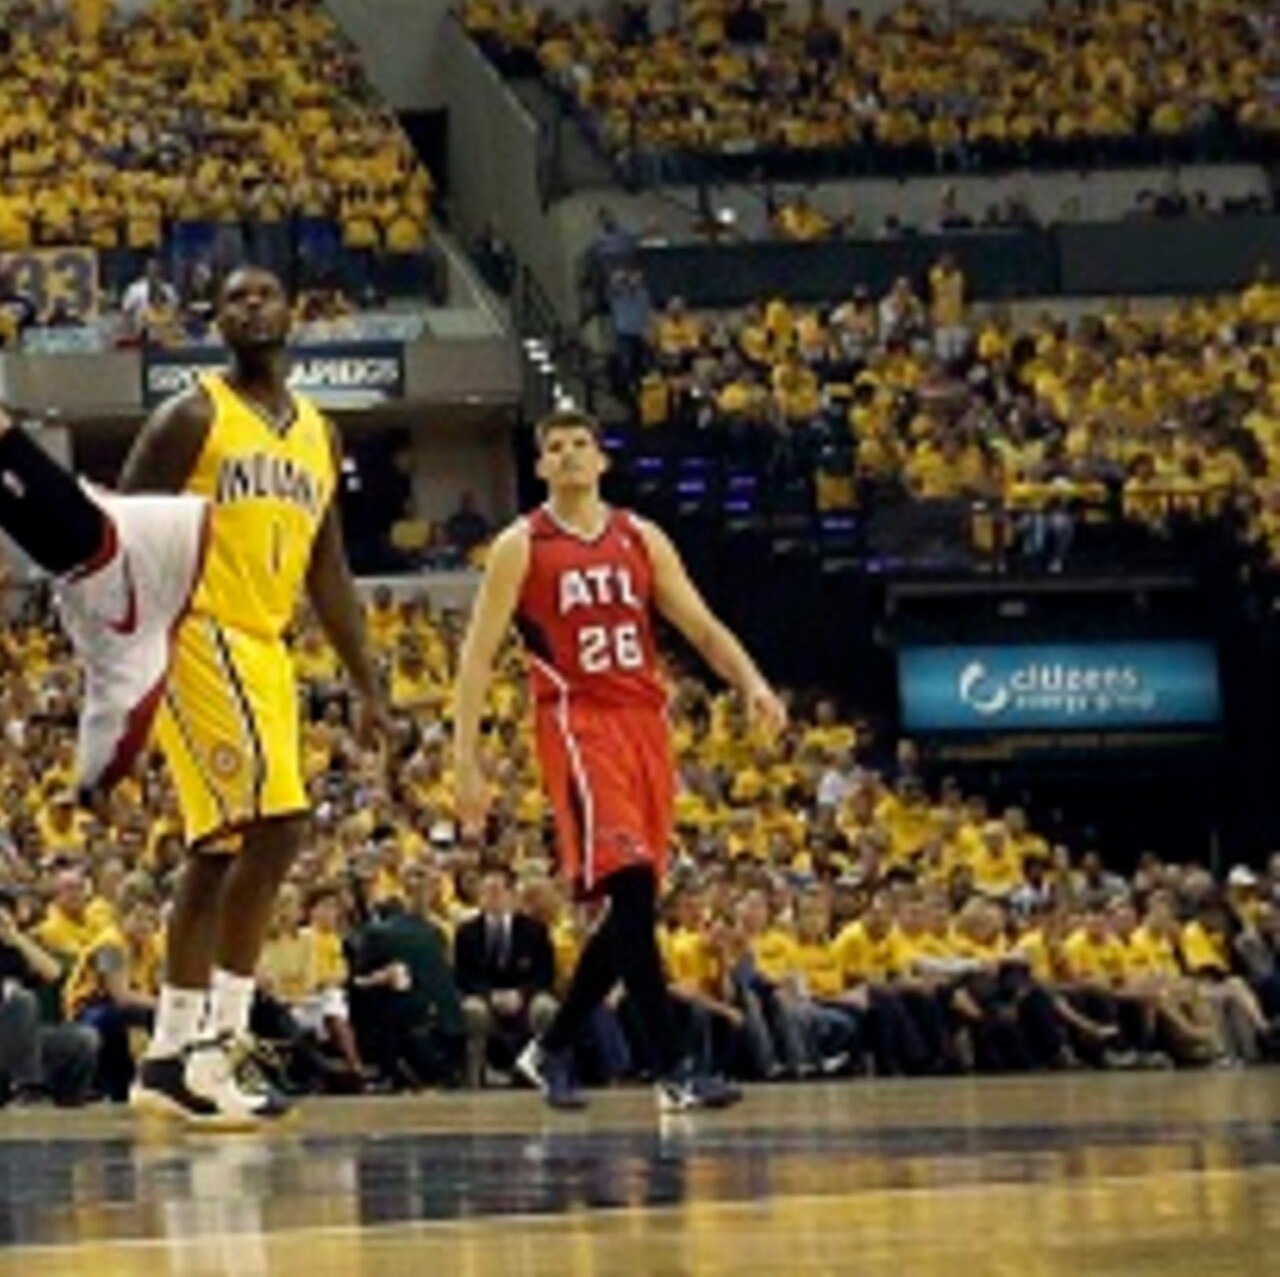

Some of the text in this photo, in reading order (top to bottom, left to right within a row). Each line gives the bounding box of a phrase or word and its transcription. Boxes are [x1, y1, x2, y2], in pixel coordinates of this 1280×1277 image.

[267, 520, 284, 574] 1
[559, 564, 644, 616] ATL
[578, 623, 644, 673] 26
[1011, 664, 1138, 691] citizens
